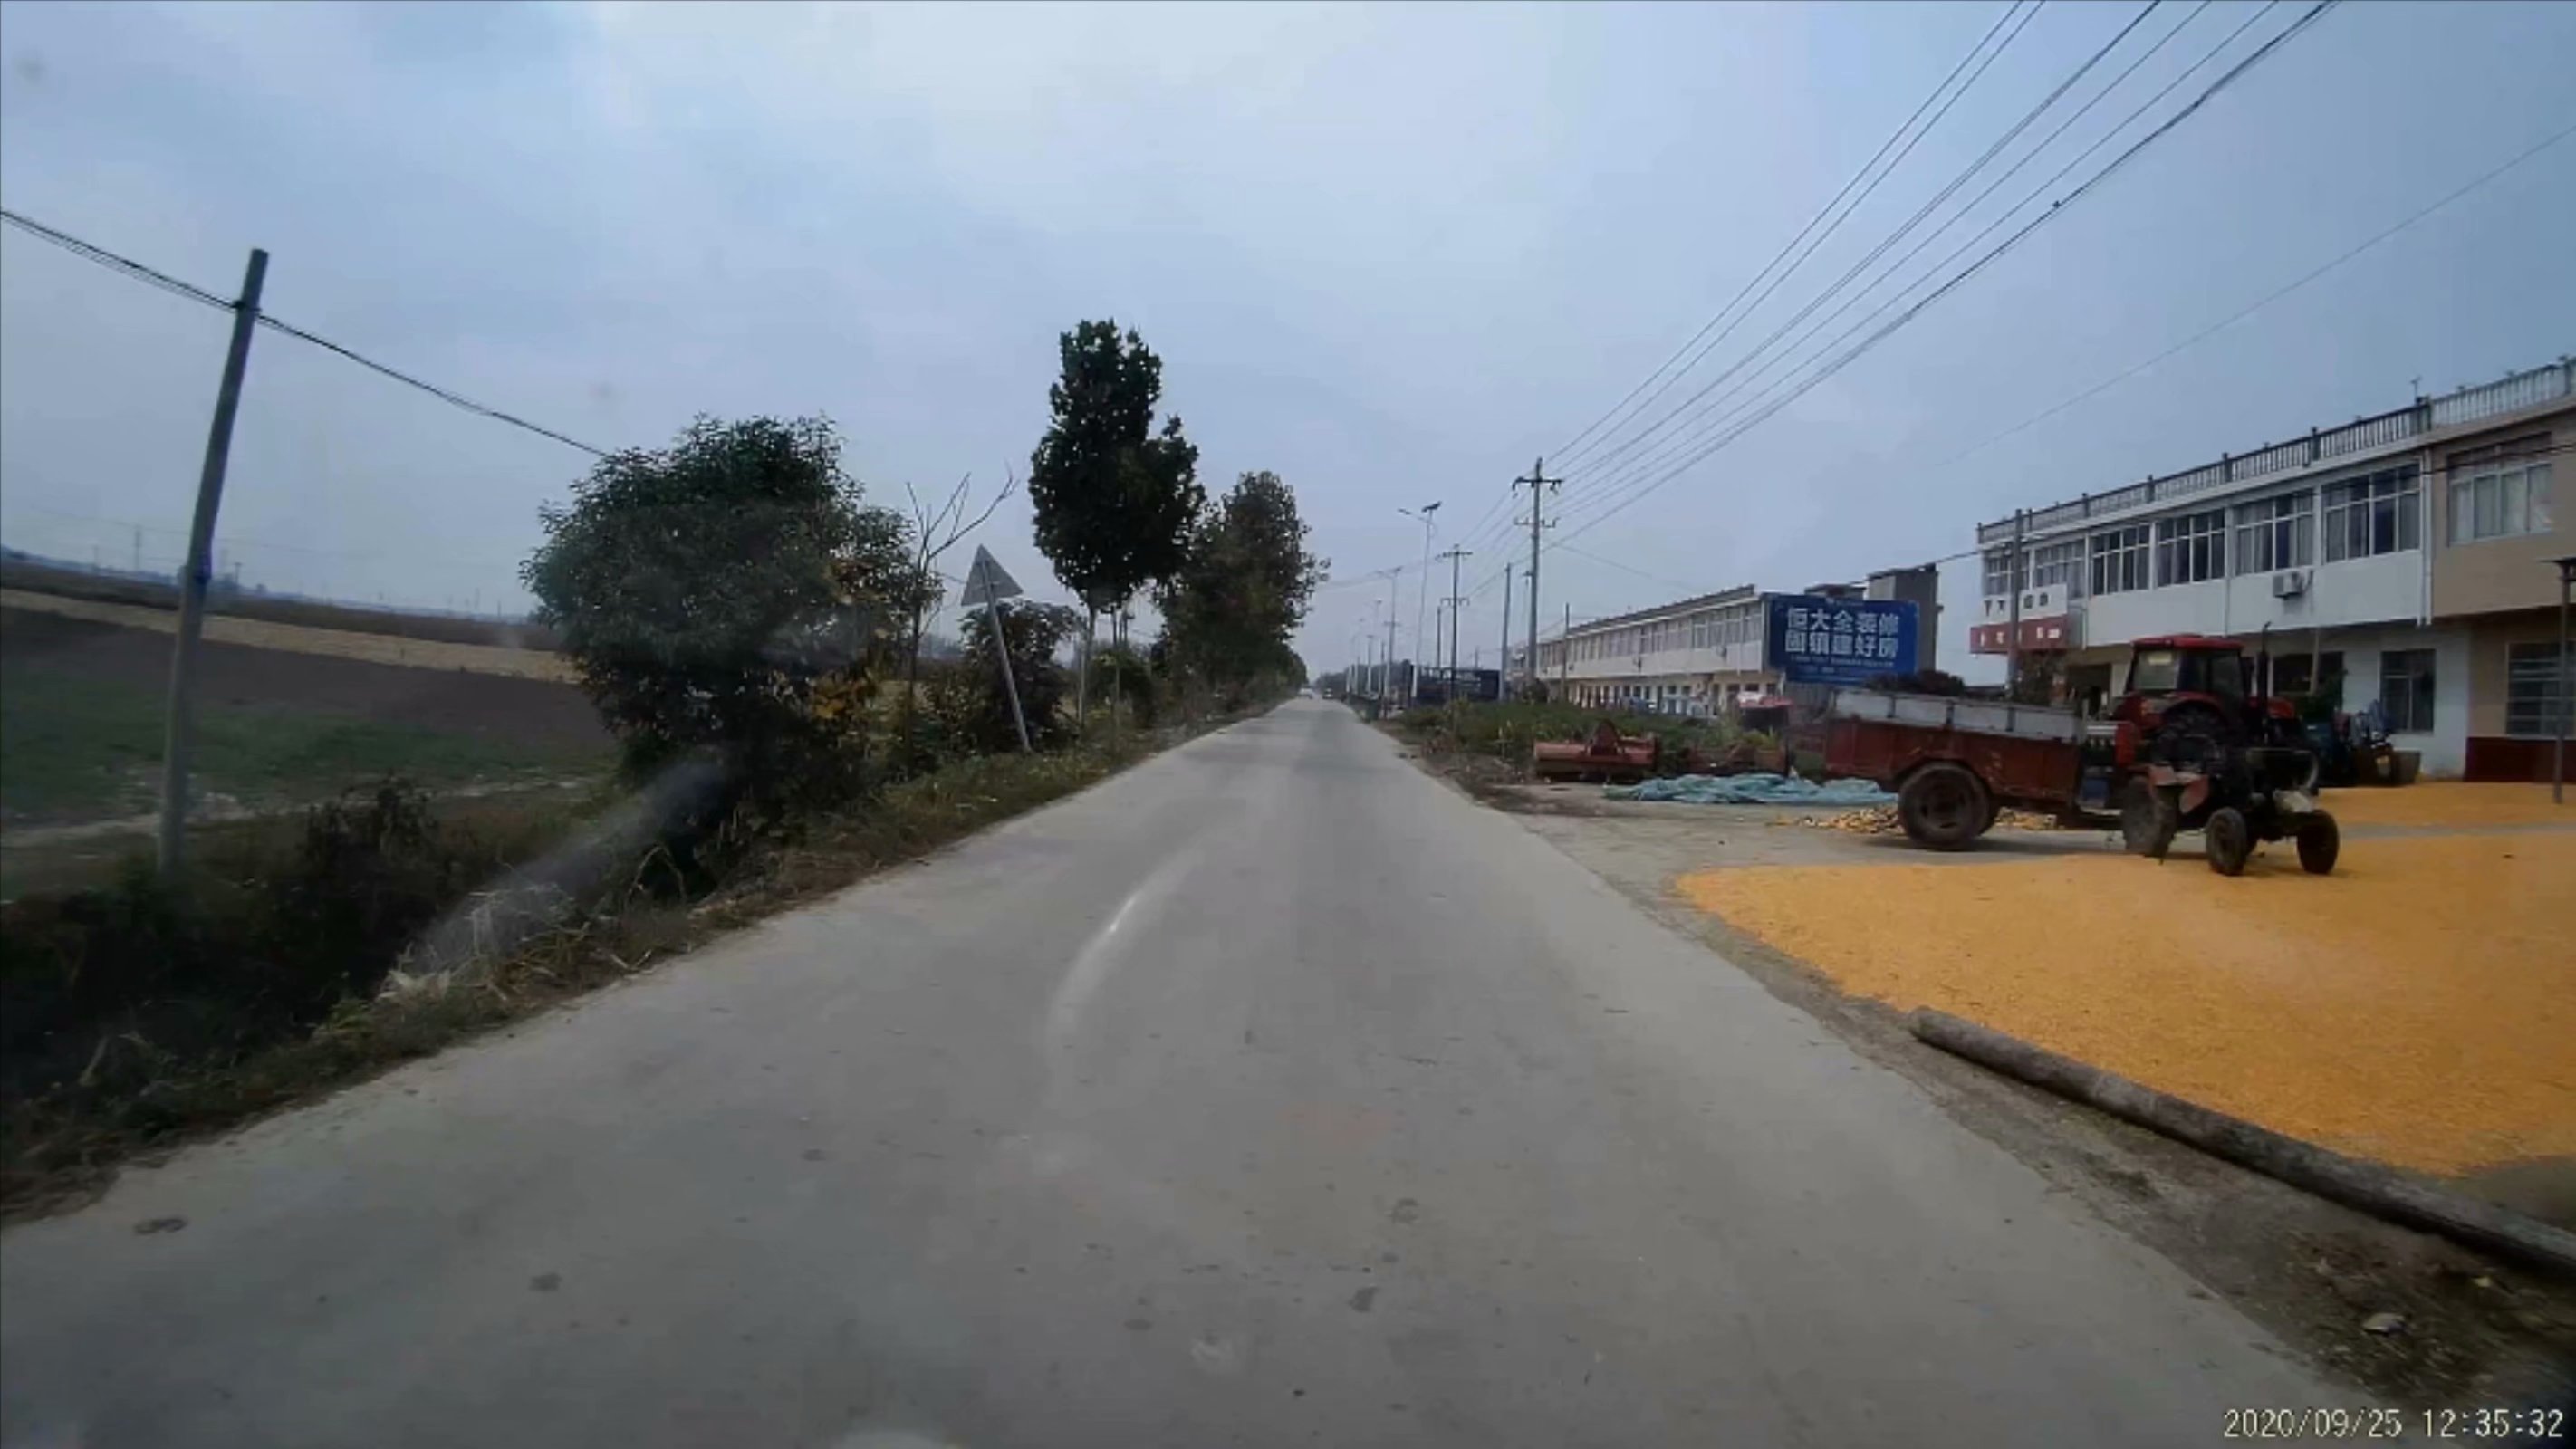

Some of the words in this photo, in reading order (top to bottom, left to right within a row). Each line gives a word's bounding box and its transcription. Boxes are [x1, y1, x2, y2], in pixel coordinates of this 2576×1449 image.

[1787, 607, 1899, 635] 恒大全装修
